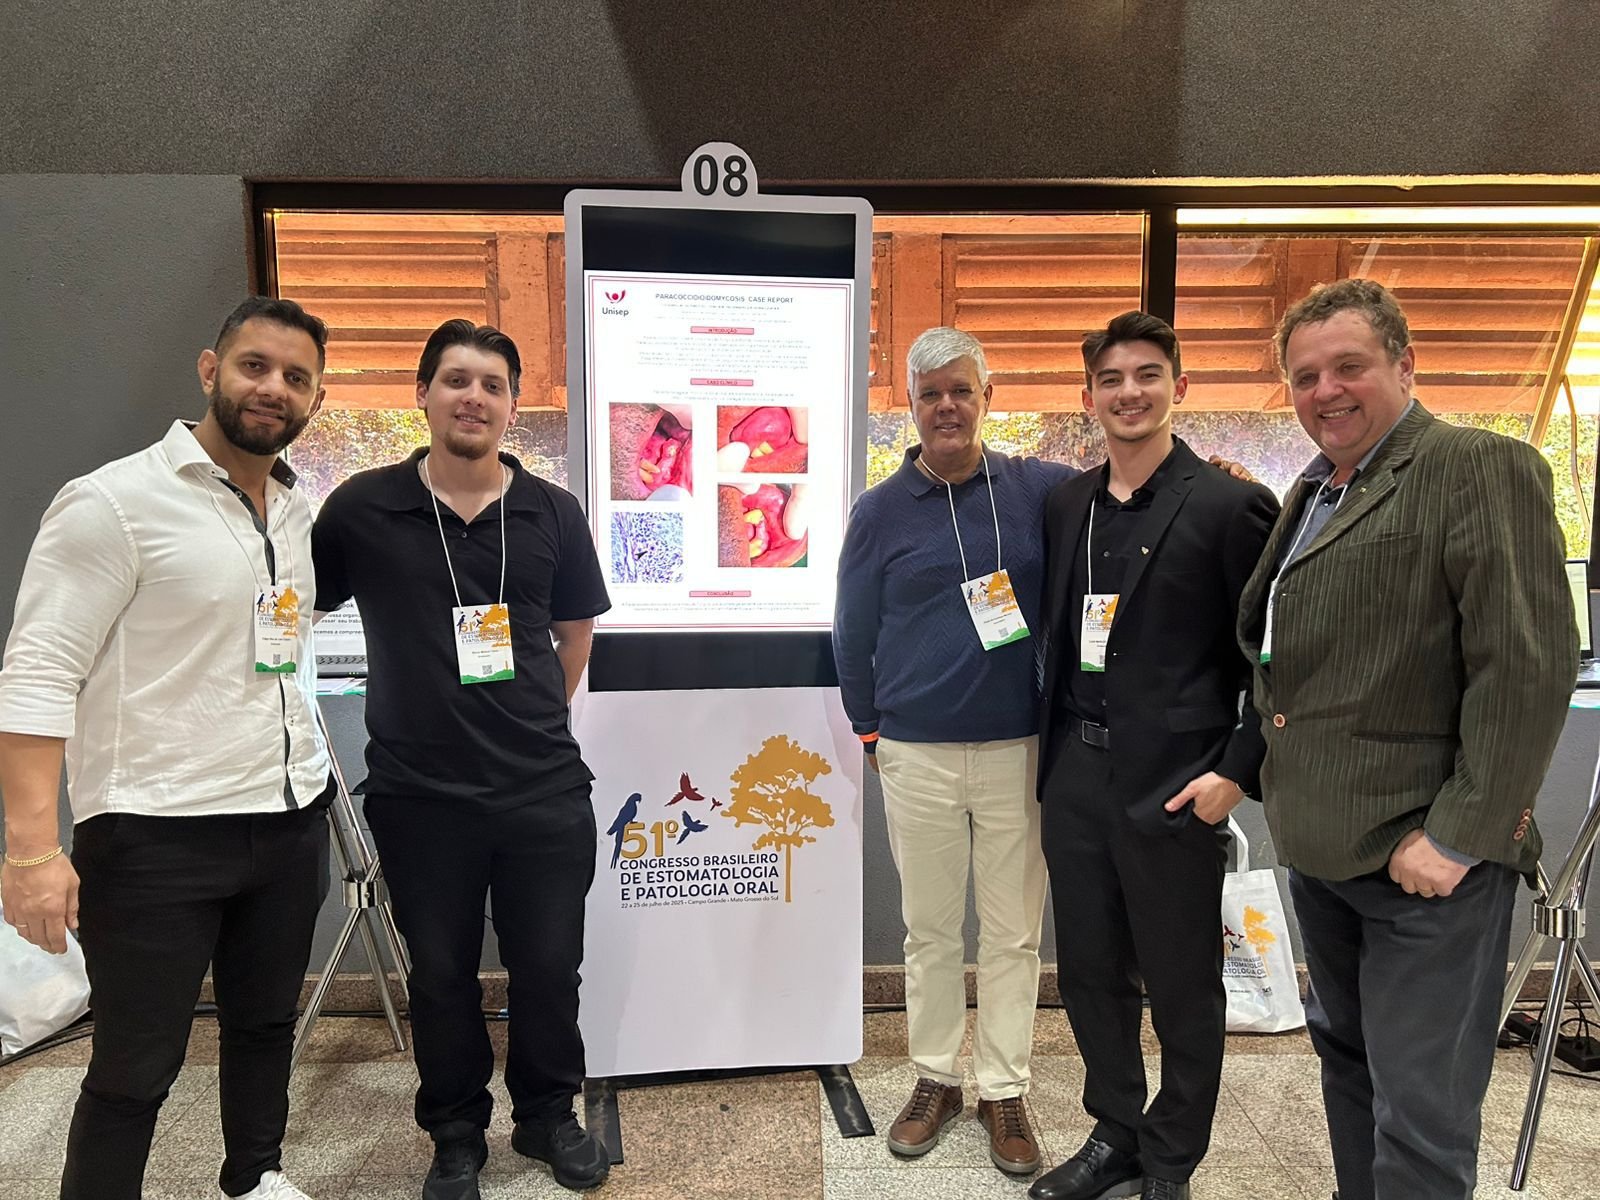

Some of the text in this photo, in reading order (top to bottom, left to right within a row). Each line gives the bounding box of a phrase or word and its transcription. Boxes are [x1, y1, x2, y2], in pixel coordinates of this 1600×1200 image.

[693, 154, 748, 197] 08
[767, 296, 794, 304] REPORT
[602, 307, 630, 317] Unisep
[620, 853, 778, 870] CONGRESSO BRASILEIRO
[620, 866, 779, 885] DE ESTOMATOLOGIA
[621, 881, 779, 901] E PATOLOGIA ORAL
